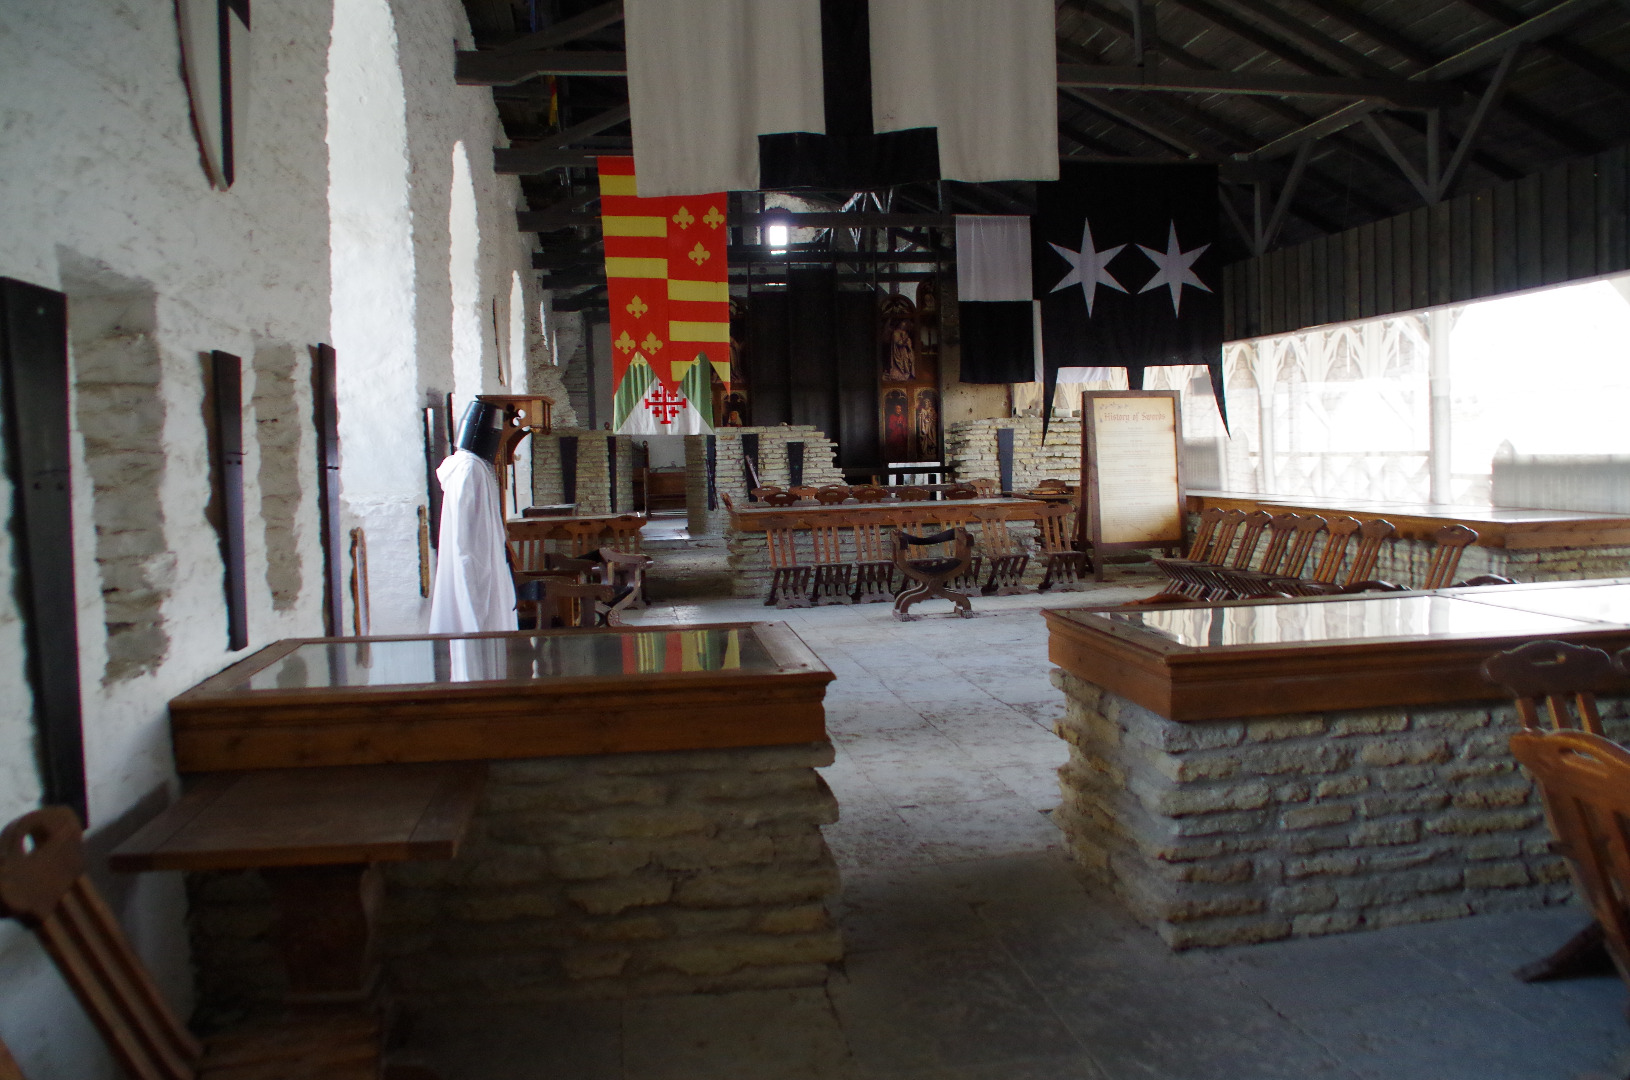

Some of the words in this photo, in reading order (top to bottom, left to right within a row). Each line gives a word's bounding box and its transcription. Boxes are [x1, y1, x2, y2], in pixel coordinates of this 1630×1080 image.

[1104, 412, 1130, 422] History
[1132, 412, 1139, 422] of
[1141, 411, 1166, 421] Swords
